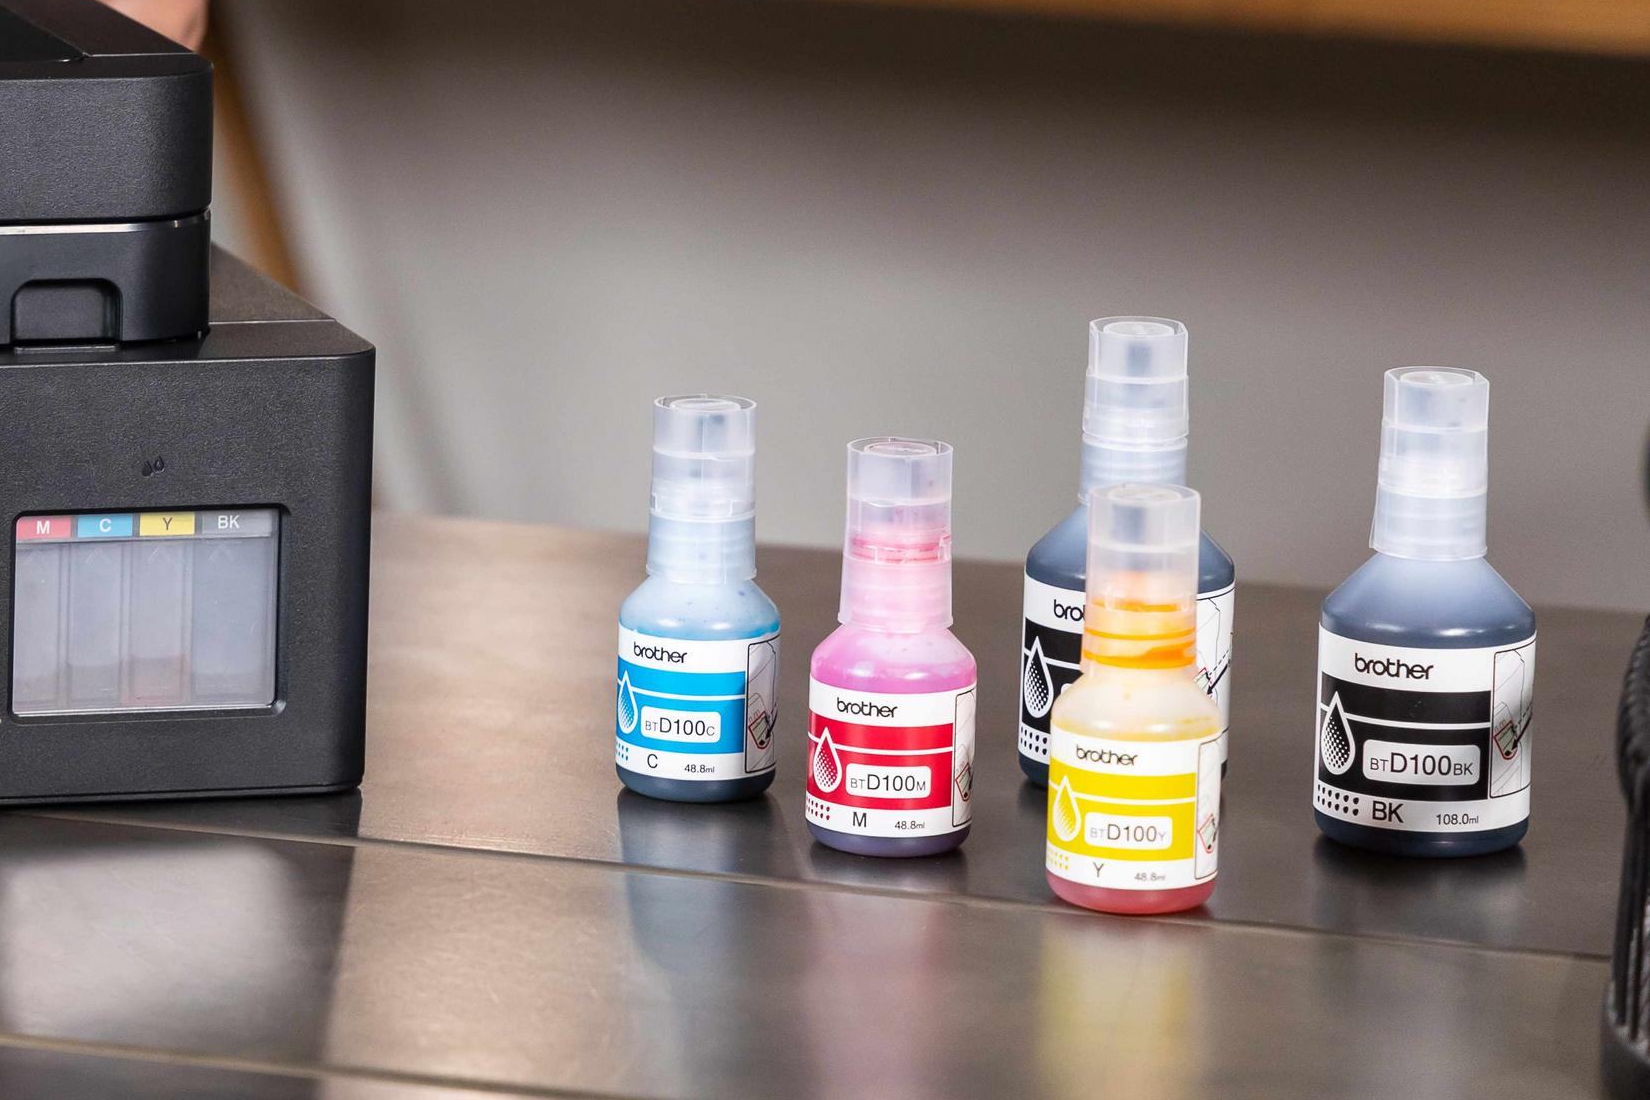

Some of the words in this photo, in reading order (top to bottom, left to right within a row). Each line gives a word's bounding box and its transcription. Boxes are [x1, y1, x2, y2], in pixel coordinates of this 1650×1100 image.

[36, 520, 51, 535] M
[99, 518, 112, 533] C
[162, 517, 173, 531] Y
[218, 515, 240, 530] BK
[633, 641, 687, 664] brother
[1354, 652, 1434, 680] brother
[836, 697, 898, 718] brother
[647, 753, 658, 769] C
[684, 764, 715, 773] 48.8ml
[1076, 744, 1138, 766] brother
[852, 811, 867, 828] M
[894, 820, 925, 830] 48.8ml
[1371, 800, 1404, 823] BK
[1436, 813, 1479, 825] 108.0ml
[1093, 861, 1104, 877] Y
